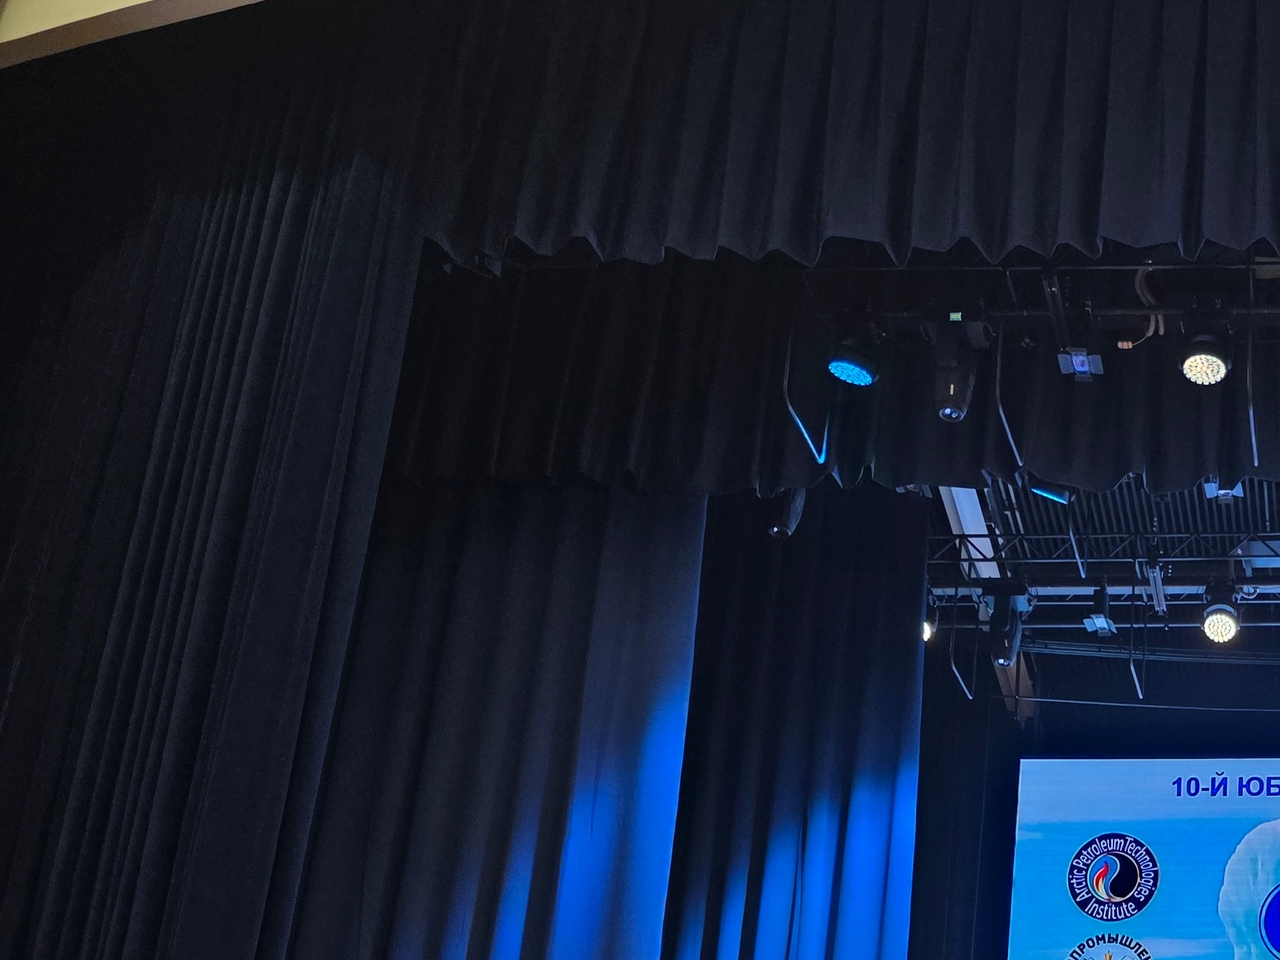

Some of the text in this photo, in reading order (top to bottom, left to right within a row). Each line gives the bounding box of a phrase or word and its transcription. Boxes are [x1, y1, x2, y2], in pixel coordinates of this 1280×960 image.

[1171, 771, 1229, 798] 10-Й
[1069, 869, 1092, 902] Arctic
[1085, 898, 1138, 920] Institute
